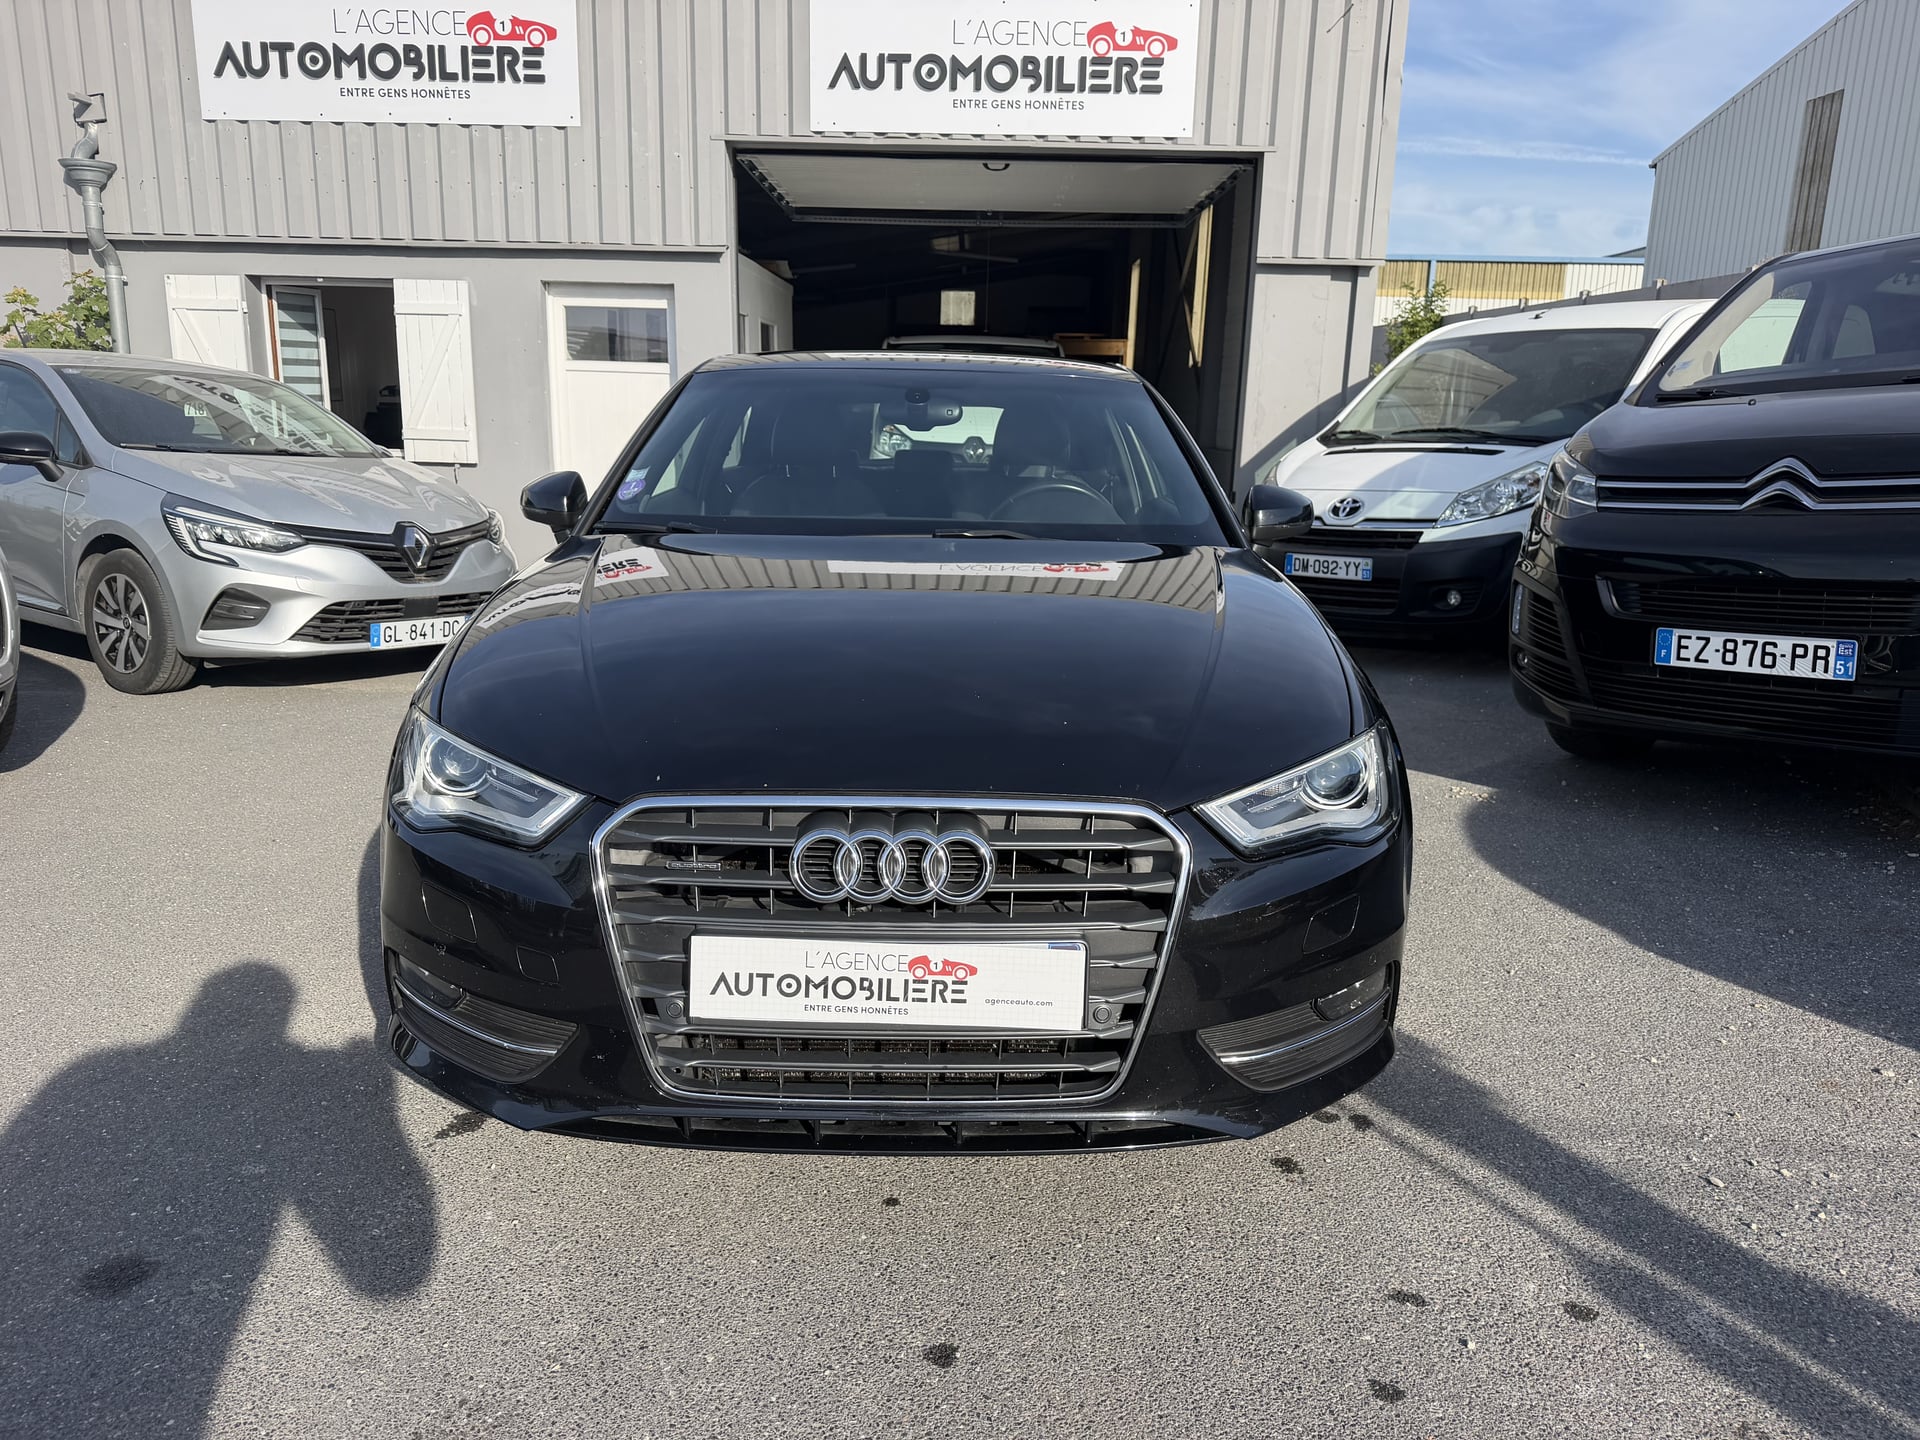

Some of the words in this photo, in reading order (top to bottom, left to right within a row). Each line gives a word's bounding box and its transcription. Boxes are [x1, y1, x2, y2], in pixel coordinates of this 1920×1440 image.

[333, 8, 467, 36] L'AGENCE
[499, 20, 506, 32] 1
[953, 19, 1088, 47] L'AGENCE
[1120, 30, 1128, 42] 1
[213, 40, 546, 84] AUTOMOBILIERE
[827, 52, 1165, 95] AUTOMOBILIERE
[340, 87, 375, 98] ENTRE
[377, 87, 408, 98] GENS
[411, 86, 471, 99] HONNÊTES
[953, 99, 988, 109] ENTRE
[991, 99, 1021, 110] GENS
[1024, 97, 1085, 111] HONNÊTES
[1293, 557, 1361, 576] DM-092-YY
[1675, 634, 1831, 674] EZ-876-PR
[1835, 660, 1853, 675] 51
[805, 950, 909, 973] L'AGENCE
[709, 971, 968, 1004] AUTOMOBILIERE
[804, 1004, 832, 1013] ENTRE
[834, 1005, 859, 1014] GENS
[861, 1004, 909, 1015] HONNÊTES
[984, 998, 1053, 1007] agenceauto.com
